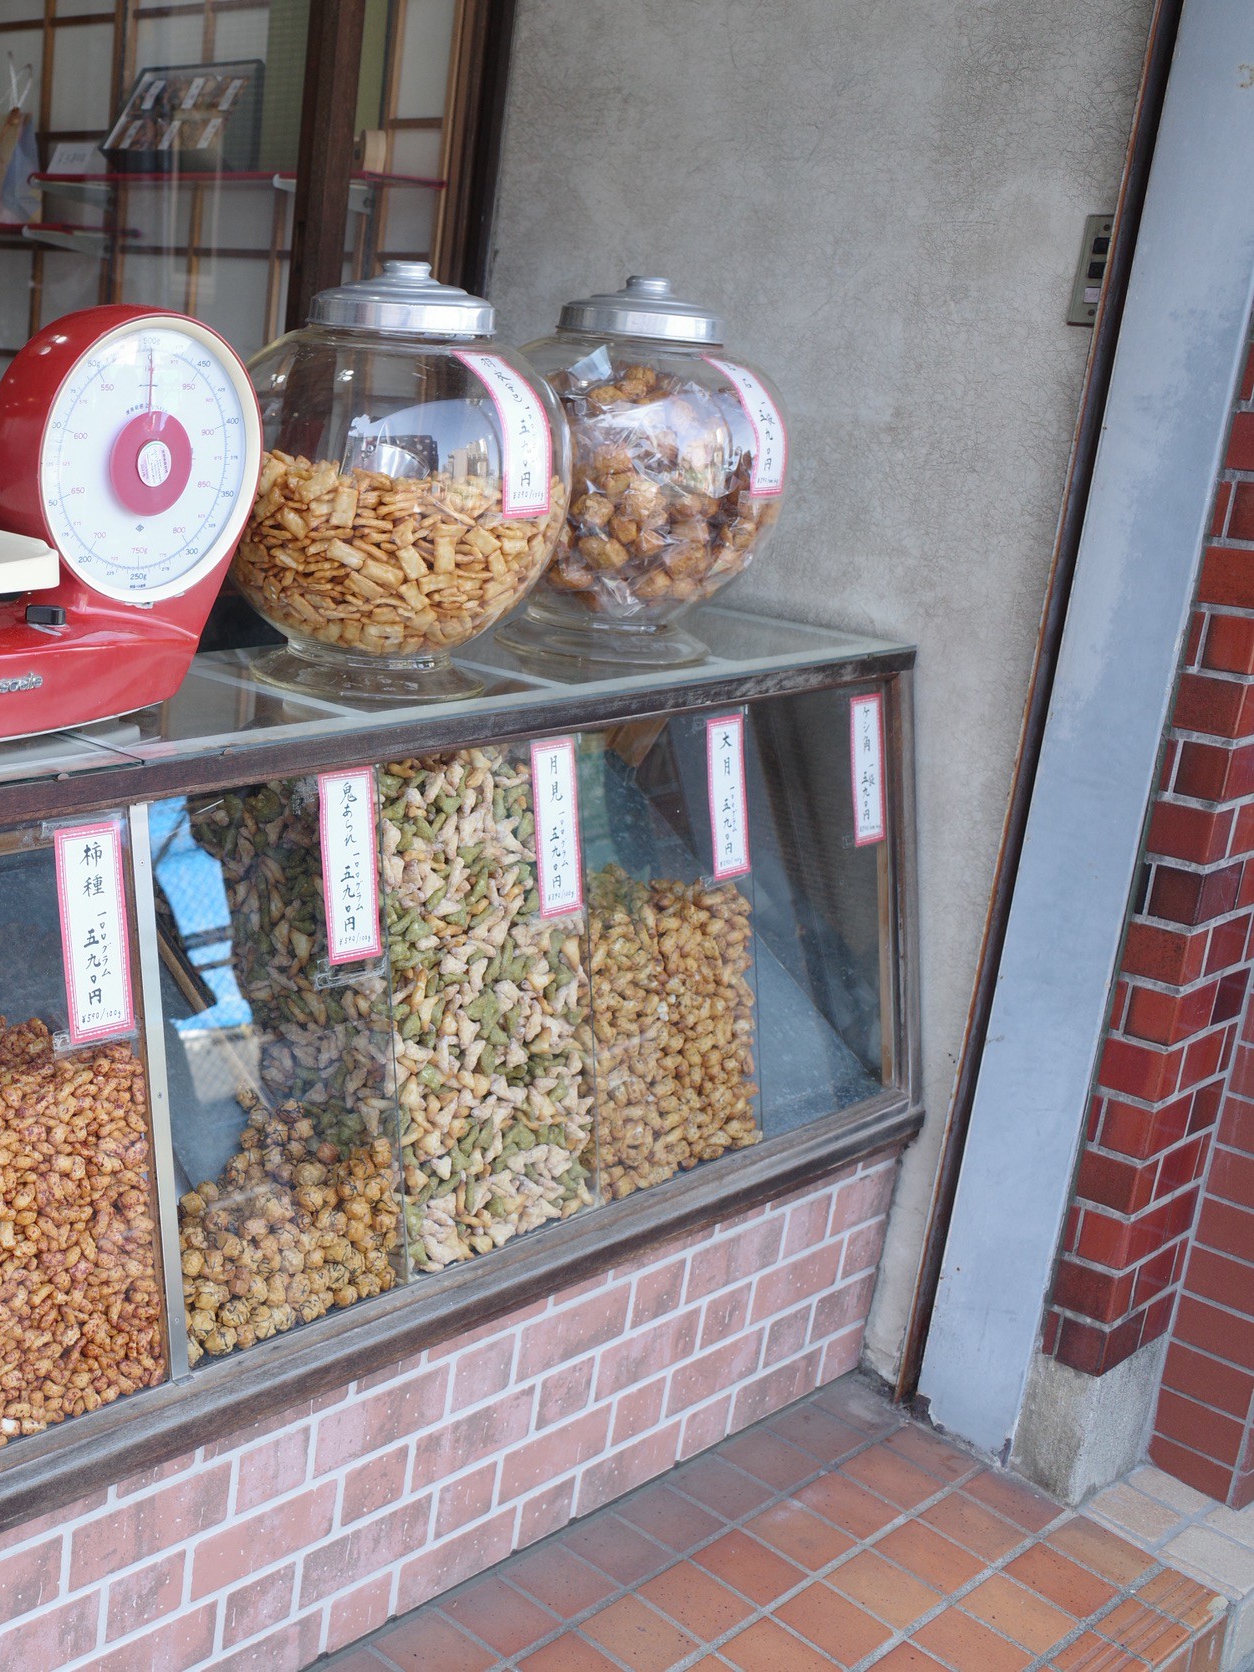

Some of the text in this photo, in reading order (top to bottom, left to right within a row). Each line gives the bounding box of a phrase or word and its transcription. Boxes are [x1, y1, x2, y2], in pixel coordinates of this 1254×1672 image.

[51, 421, 62, 429] 00
[73, 432, 88, 440] 600
[221, 490, 234, 498] 350
[172, 526, 186, 534] 800
[131, 547, 148, 555] 750g
[129, 573, 147, 581] 250g
[549, 755, 563, 803] 月見
[339, 781, 357, 846] 鬼あられ
[79, 841, 106, 898] 柿種
[81, 1008, 122, 1024] ¥590/100g
